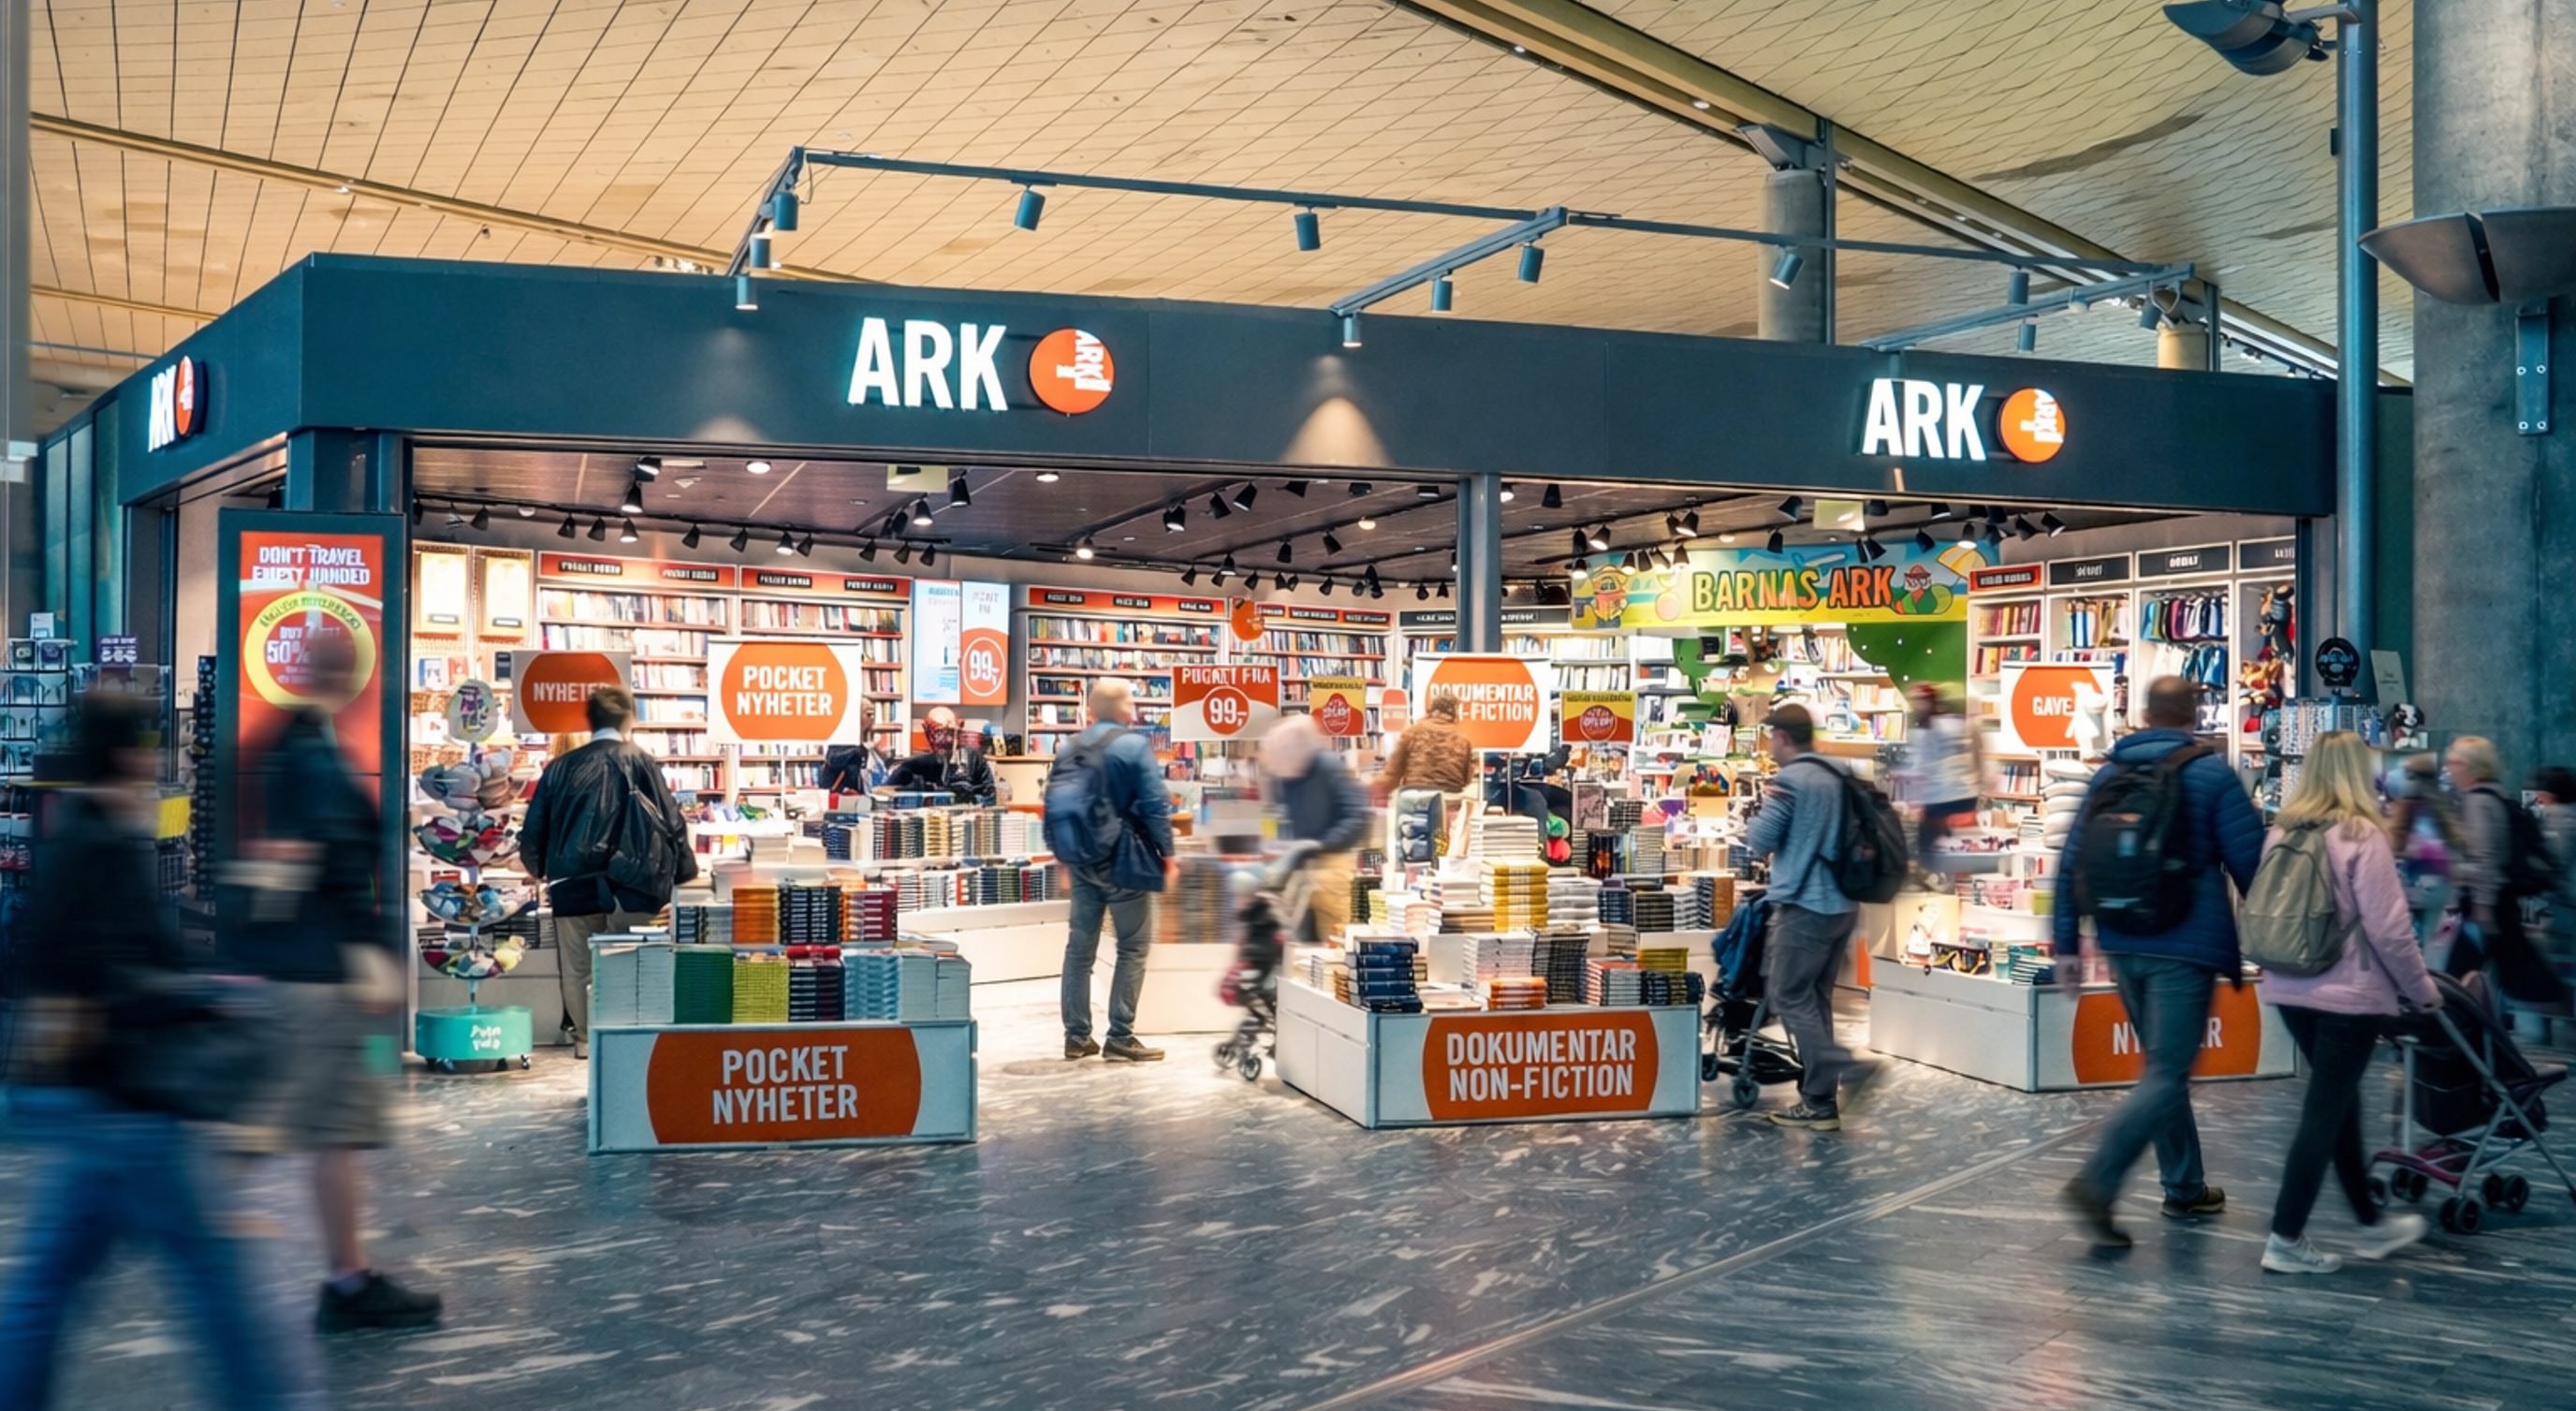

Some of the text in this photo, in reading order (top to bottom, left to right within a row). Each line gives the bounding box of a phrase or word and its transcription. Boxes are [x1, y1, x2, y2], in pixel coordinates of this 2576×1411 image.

[847, 316, 1008, 411] ARK
[1862, 378, 1986, 461] ARK
[1692, 566, 1895, 610] BARNAS ARK
[533, 682, 610, 702] NYHETE
[743, 665, 827, 690] POCKET
[737, 691, 833, 716] NYHETER
[722, 1045, 848, 1085] POCKET
[1446, 1028, 1636, 1066] DOKUMENTAR
[1449, 1064, 1633, 1102] NON-FICTION
[712, 1084, 858, 1124] NYHETER
